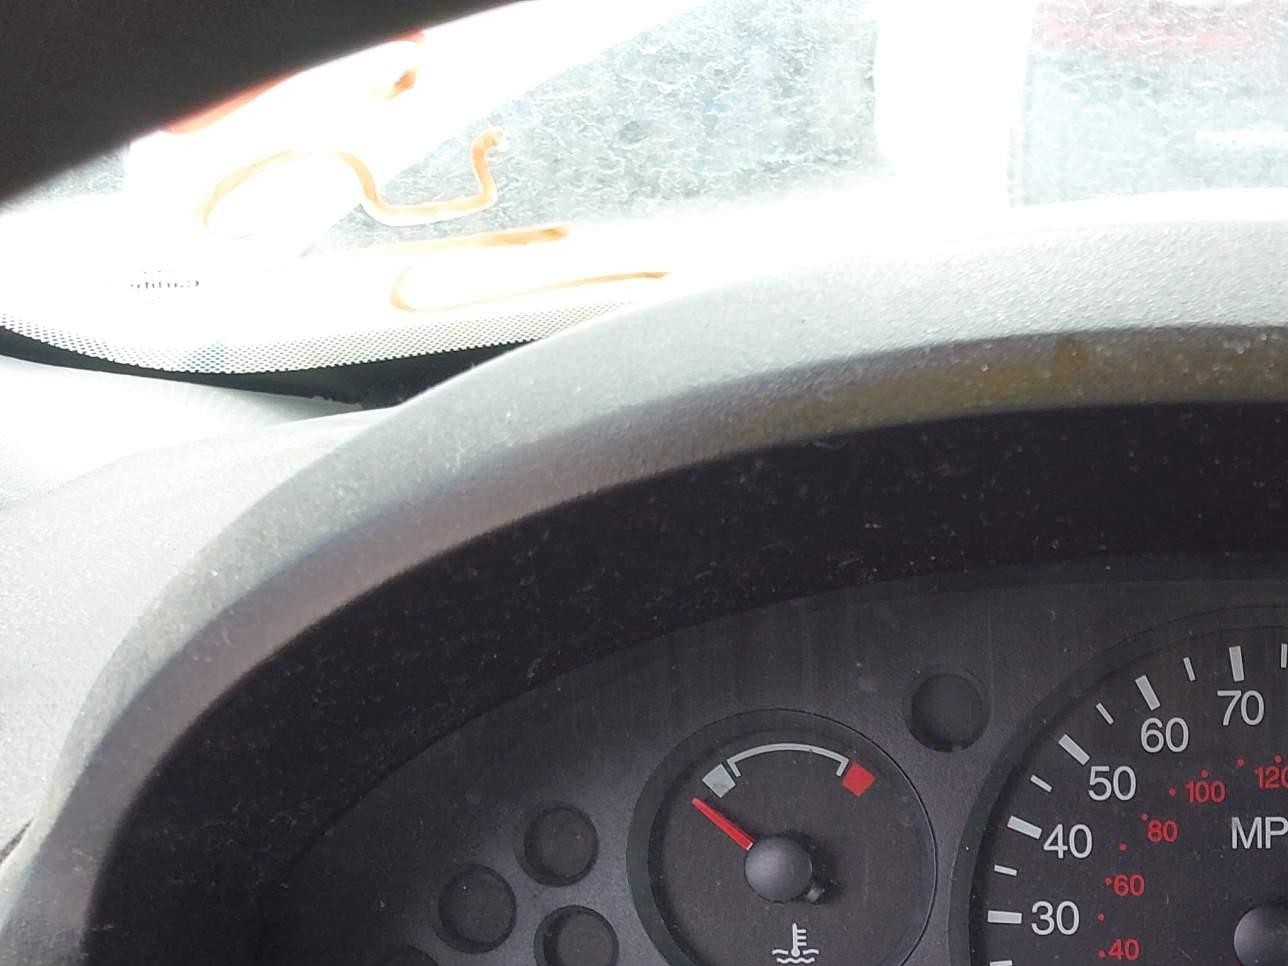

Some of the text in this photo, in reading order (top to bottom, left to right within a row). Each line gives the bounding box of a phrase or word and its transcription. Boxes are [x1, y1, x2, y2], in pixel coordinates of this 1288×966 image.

[1216, 690, 1265, 726] 70
[1140, 717, 1189, 753] 60
[1088, 766, 1137, 801] 50
[1185, 781, 1226, 804] 100
[1042, 822, 1093, 859] 40
[1146, 820, 1179, 843] 80
[1113, 875, 1145, 897] 60
[1031, 900, 1080, 936] 30
[1108, 938, 1141, 961] 40
